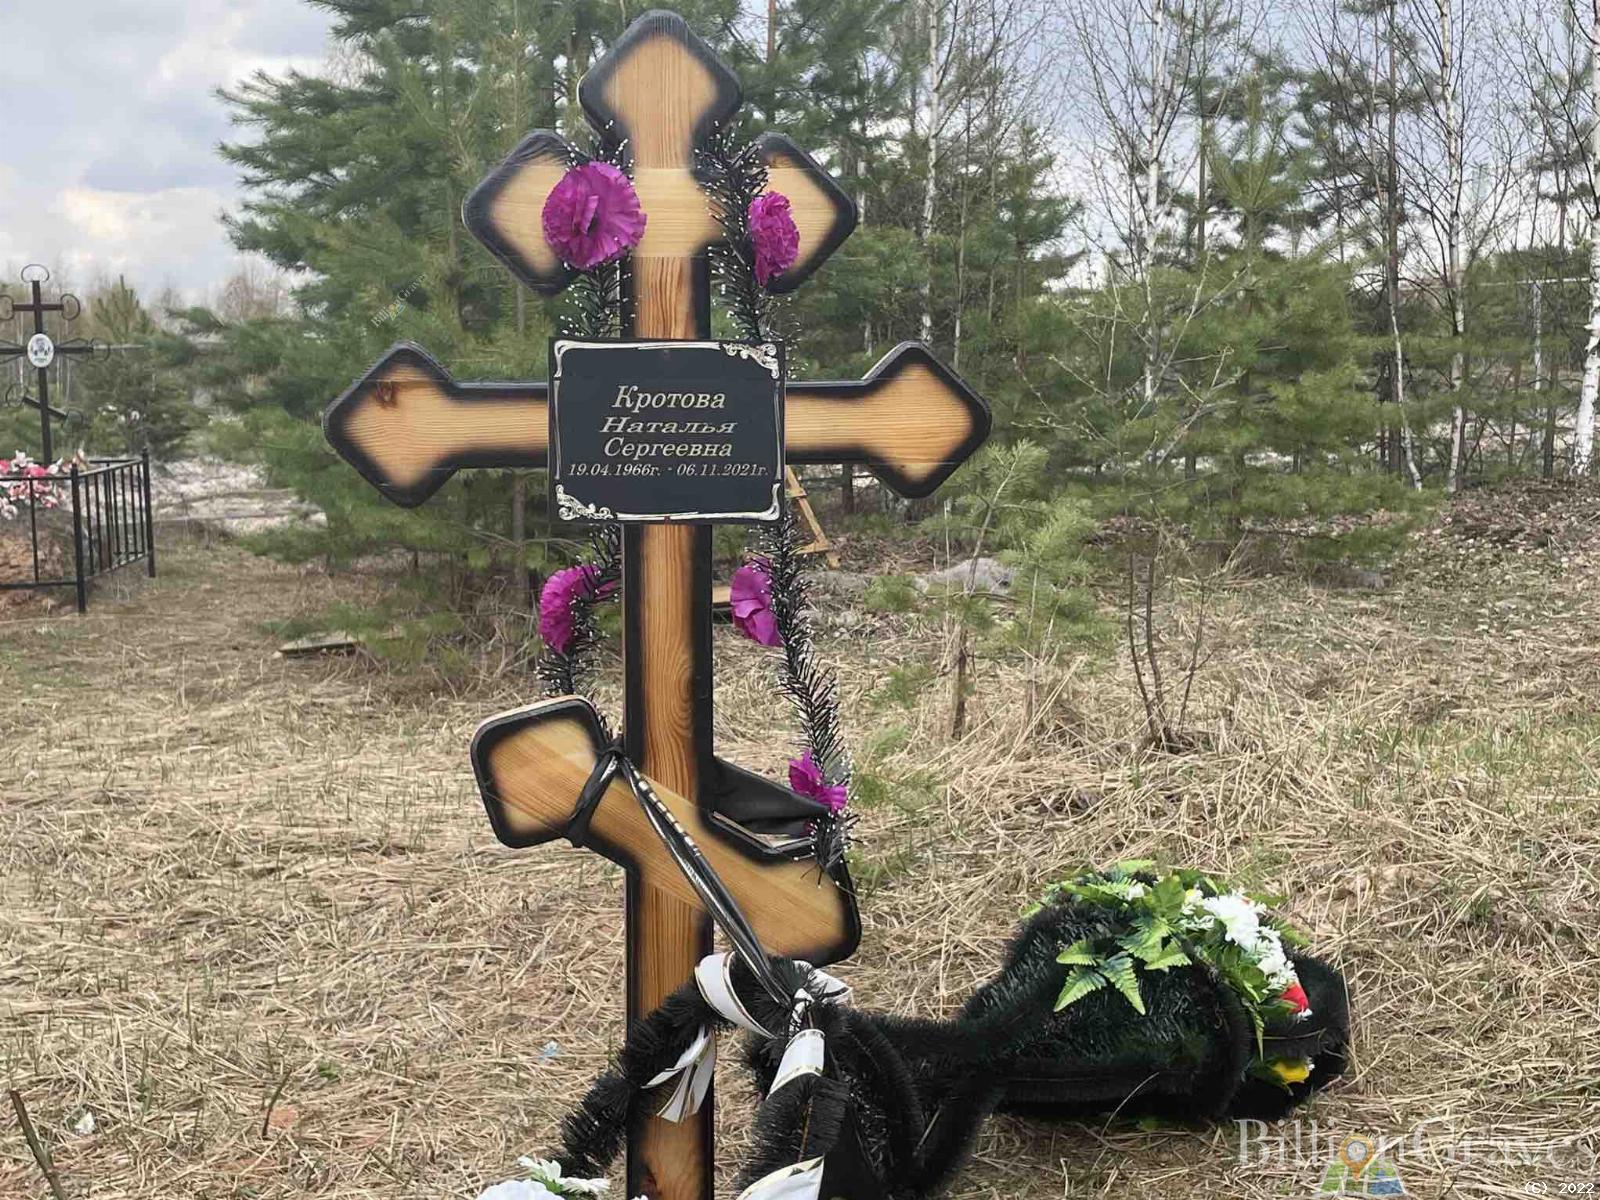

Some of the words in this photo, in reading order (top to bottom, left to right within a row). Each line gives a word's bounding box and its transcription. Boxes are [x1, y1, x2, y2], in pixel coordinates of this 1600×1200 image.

[611, 384, 727, 413] Кротова
[598, 416, 738, 434] Наталья
[603, 436, 733, 460] Сергеевна
[567, 463, 662, 477] 19.04.1966г.
[676, 463, 769, 477] 06.11.2021г.
